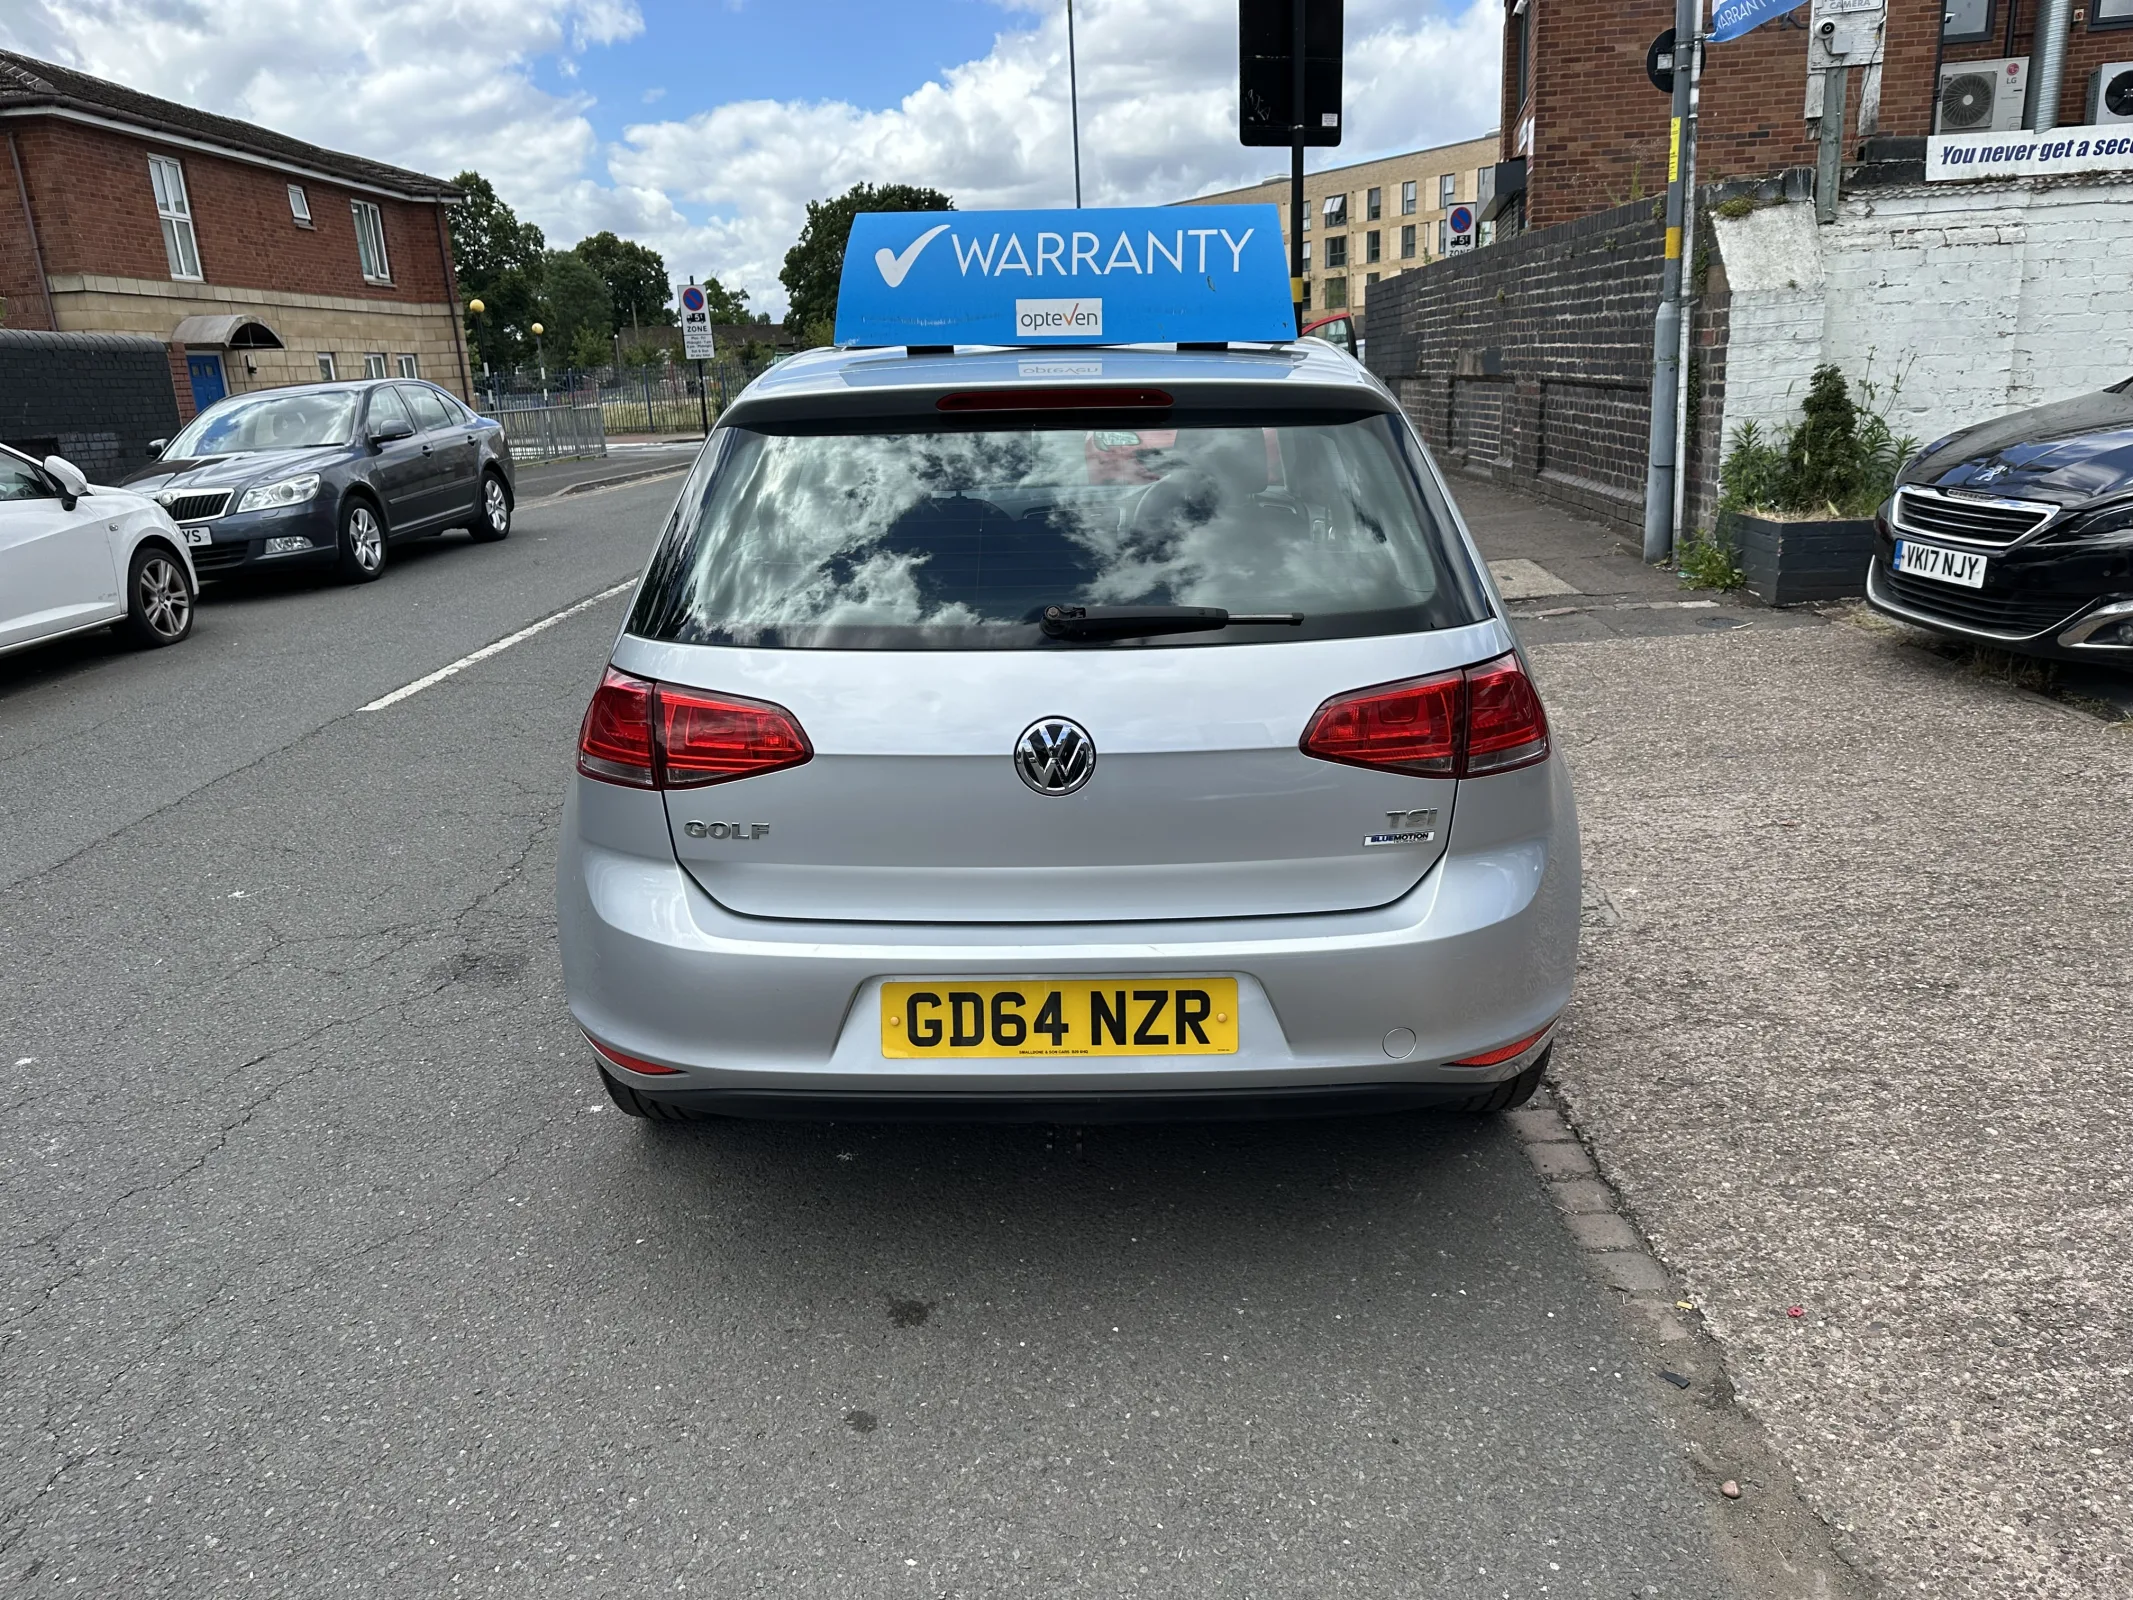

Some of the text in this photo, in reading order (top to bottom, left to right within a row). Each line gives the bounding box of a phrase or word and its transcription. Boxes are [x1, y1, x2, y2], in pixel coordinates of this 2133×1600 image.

[1830, 0, 1871, 9] CAMERA
[1941, 145, 1976, 165] You
[1978, 144, 2038, 163] never
[2038, 139, 2075, 162] get
[2076, 140, 2090, 157] a
[951, 228, 1254, 277] WARRANTY
[1020, 303, 1099, 331] opteven
[1907, 545, 1979, 580] VK17 NJY
[684, 819, 770, 840] GOLF
[1385, 807, 1438, 829] TSI
[1370, 832, 1429, 843] BLUEMOTION
[906, 990, 1211, 1047] GD64 NZR
